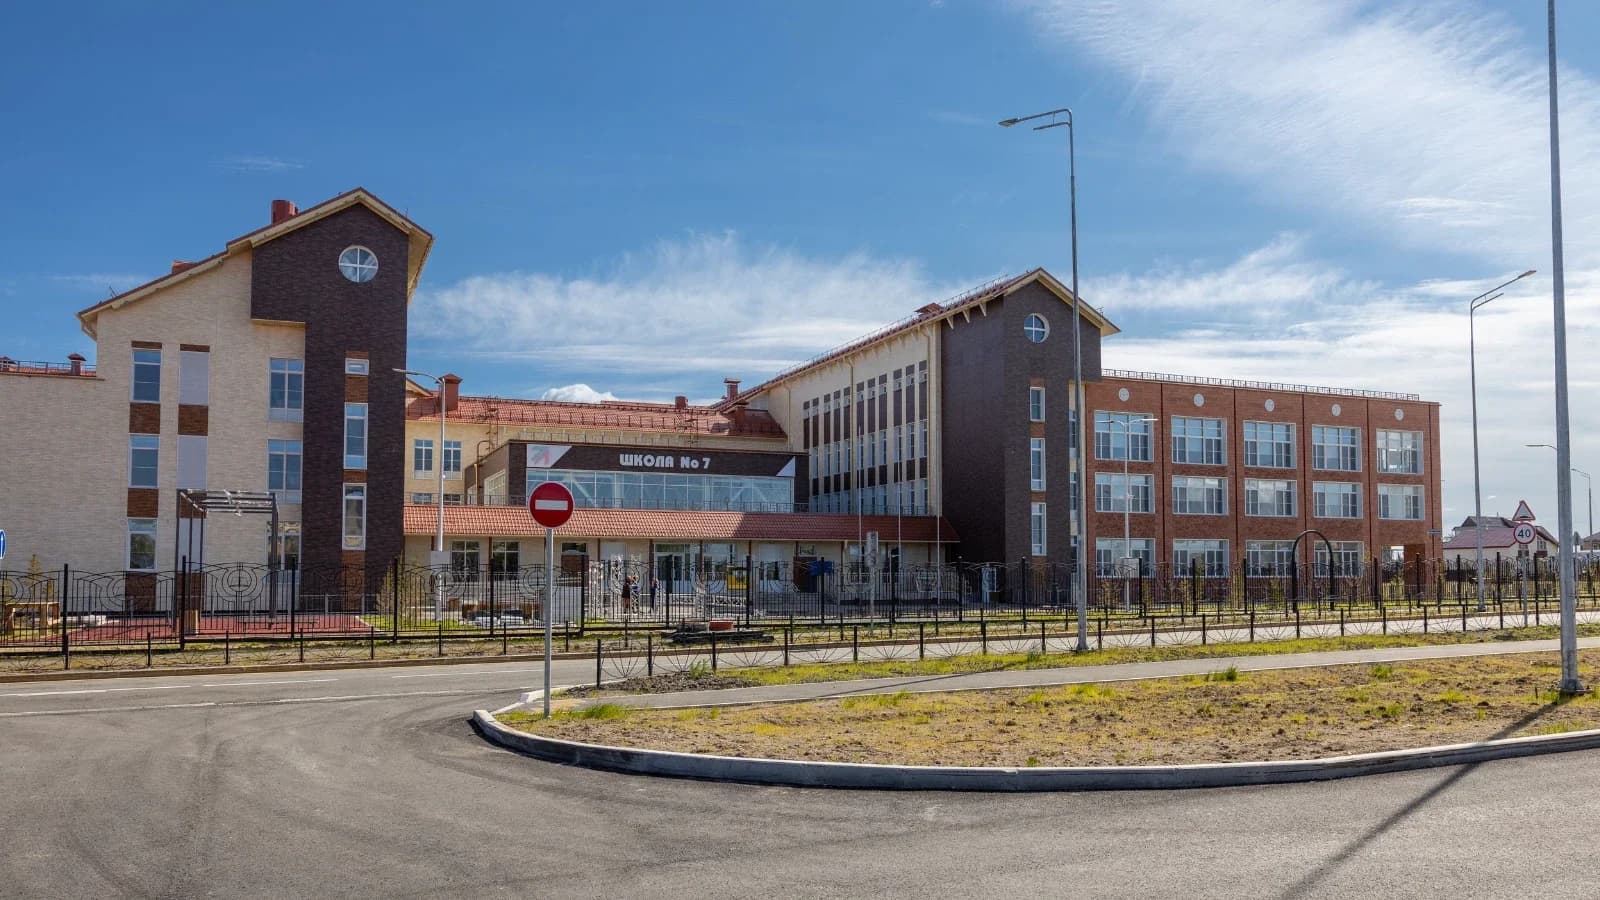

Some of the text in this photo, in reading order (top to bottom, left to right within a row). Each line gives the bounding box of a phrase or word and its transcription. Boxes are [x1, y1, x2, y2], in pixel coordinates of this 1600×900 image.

[619, 453, 674, 467] ШКОЛА
[702, 457, 711, 469] 7
[1517, 528, 1531, 538] 40
